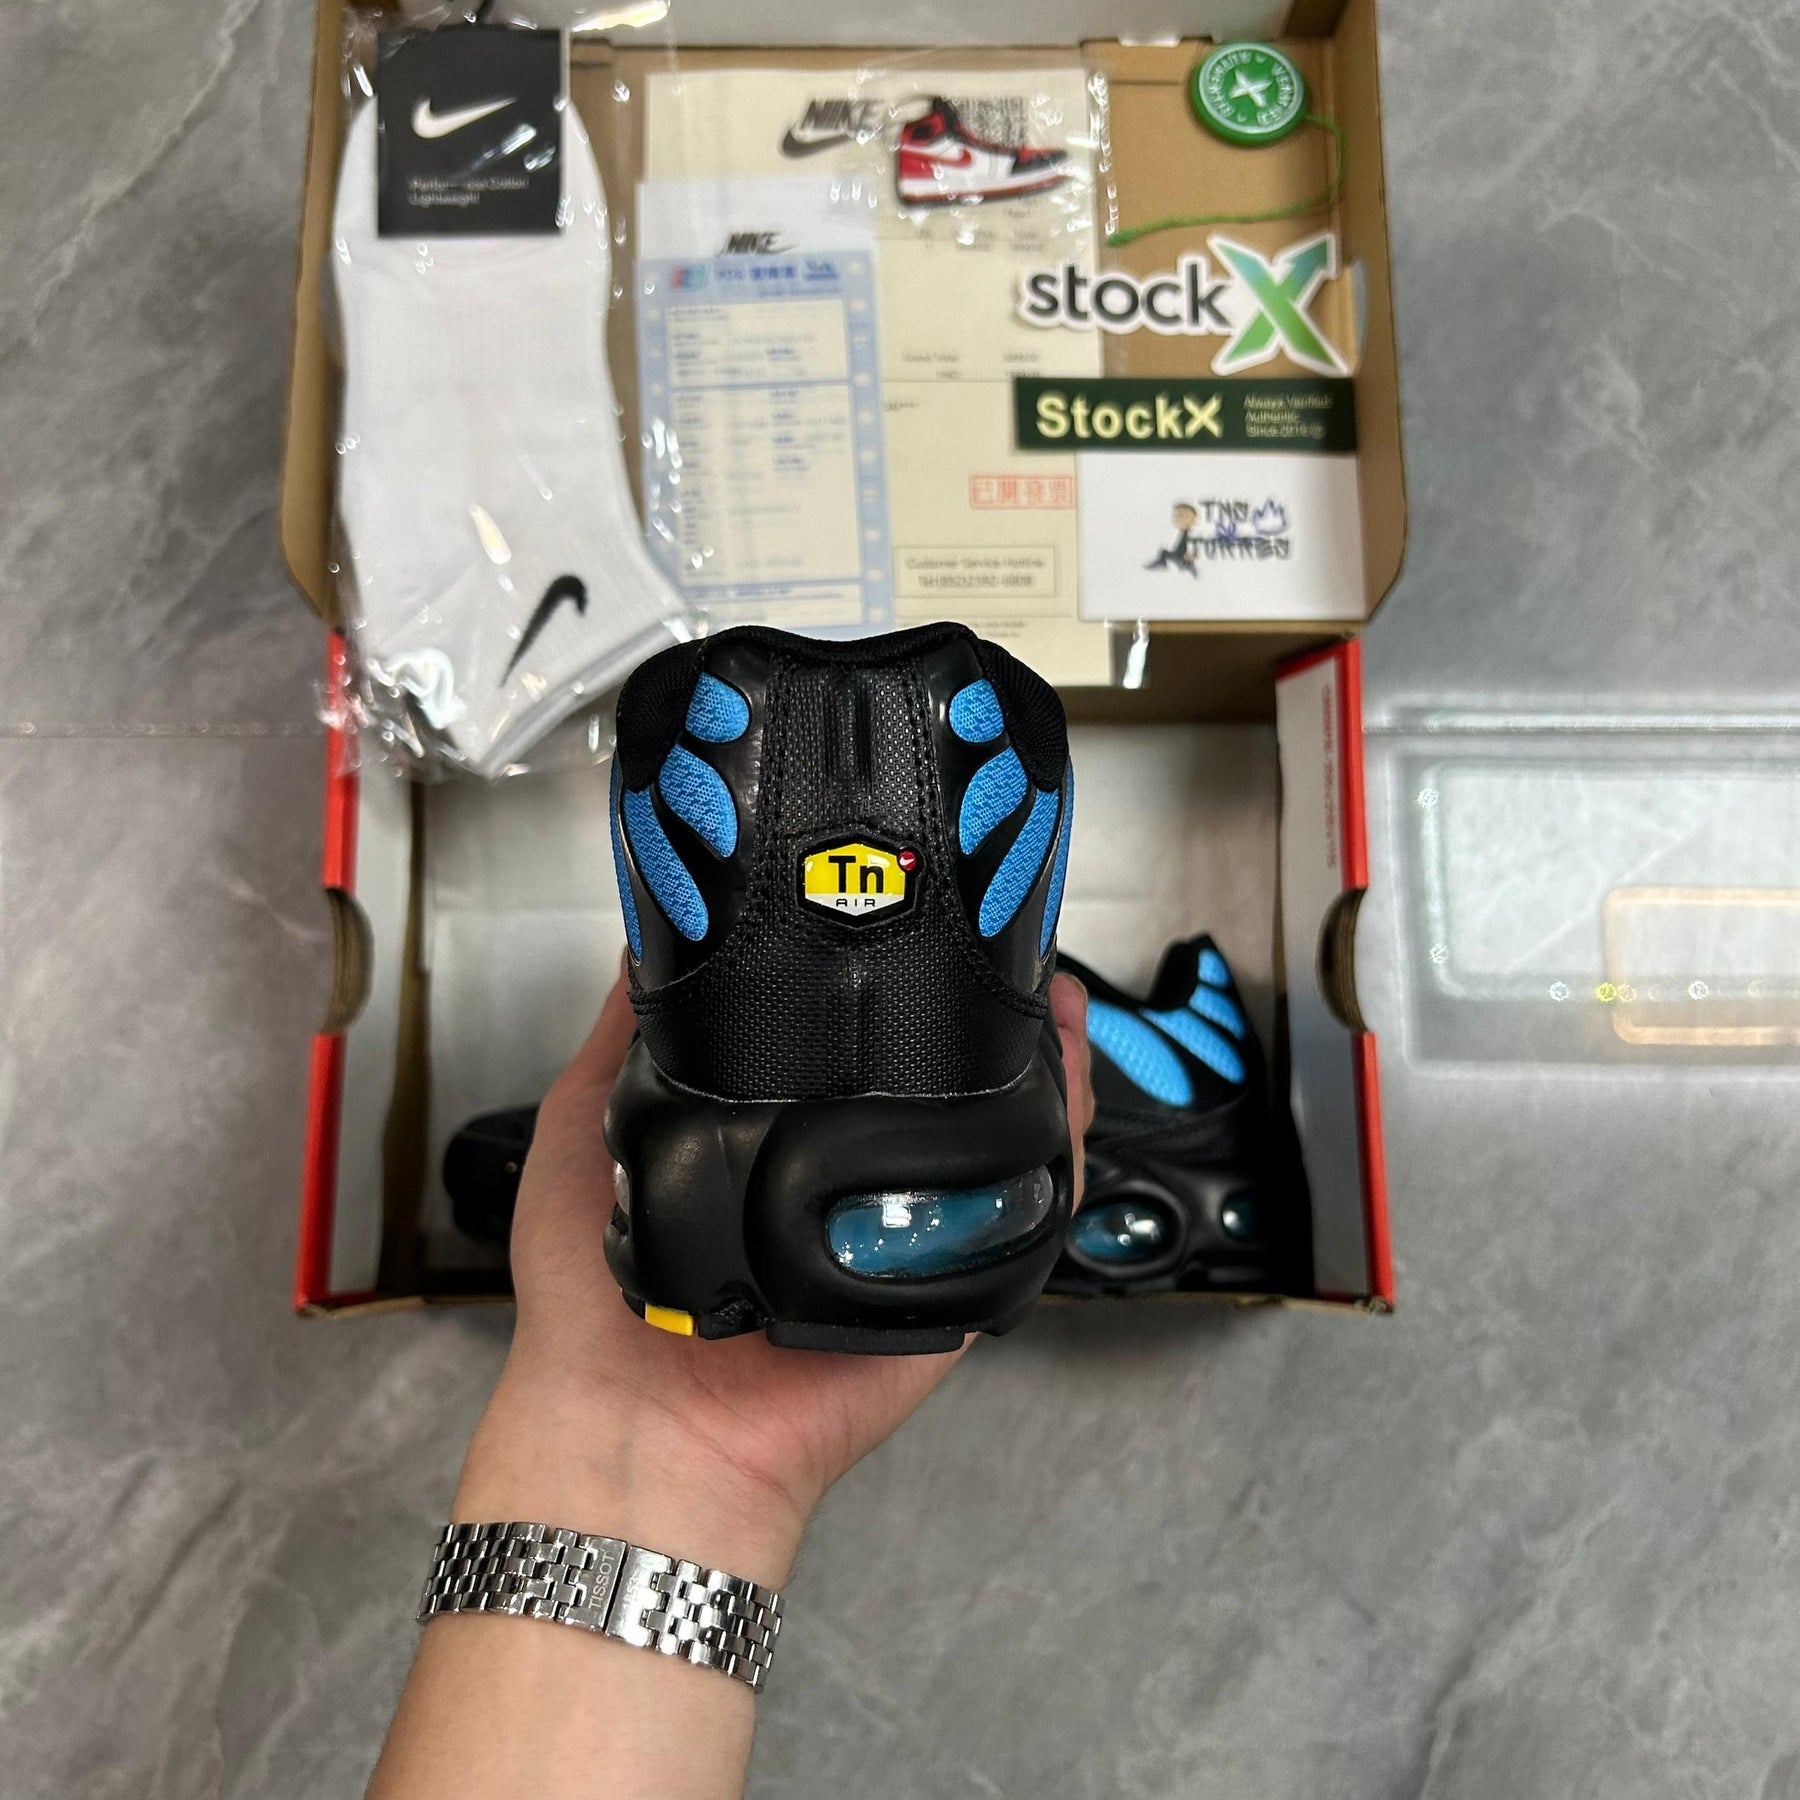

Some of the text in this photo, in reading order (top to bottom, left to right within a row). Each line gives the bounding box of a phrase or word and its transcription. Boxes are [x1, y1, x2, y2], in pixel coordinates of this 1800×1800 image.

[726, 230, 783, 254] NIKE
[1035, 391, 1224, 439] StockX
[828, 855, 884, 894] Tn
[835, 898, 876, 908] AIR
[588, 1549, 615, 1609] TISSOT
